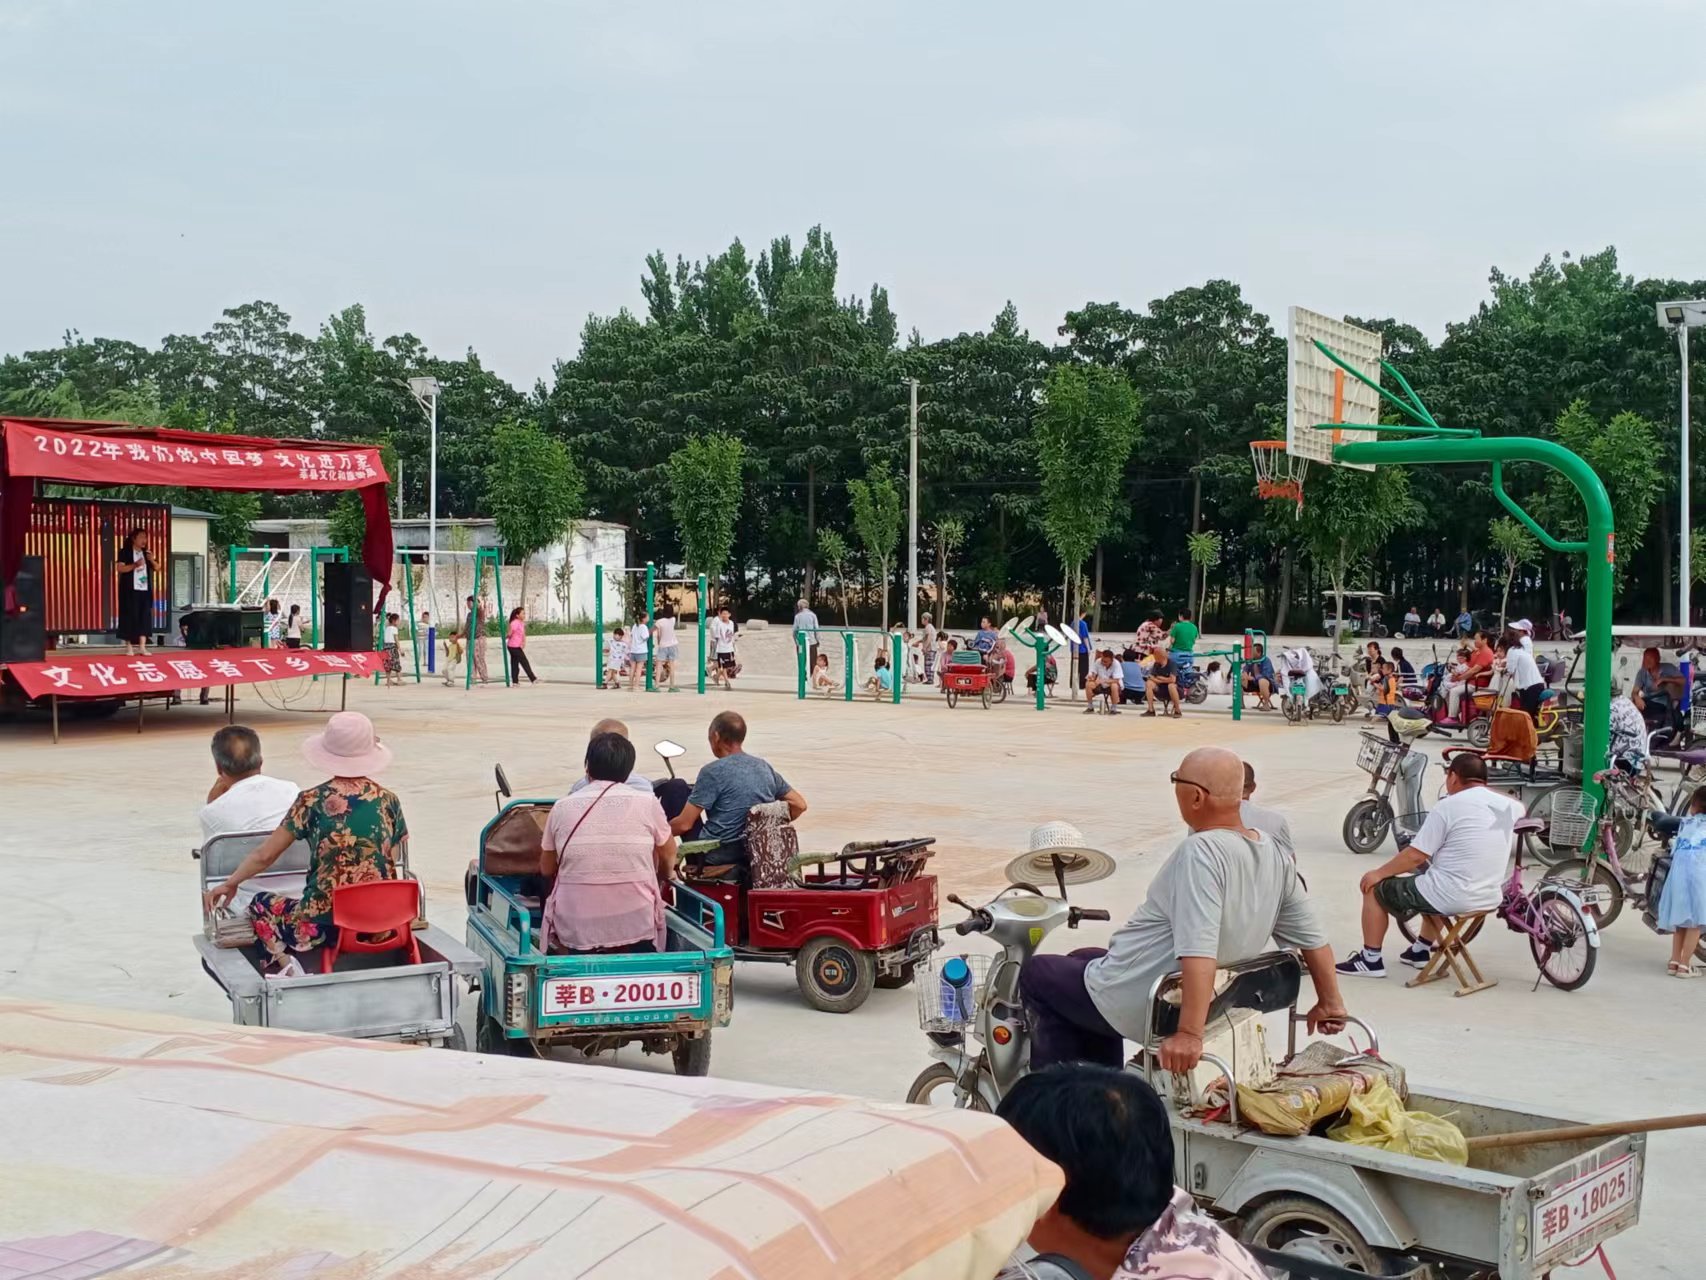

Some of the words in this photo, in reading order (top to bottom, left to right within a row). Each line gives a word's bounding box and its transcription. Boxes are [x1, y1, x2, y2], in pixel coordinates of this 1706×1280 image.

[34, 435, 263, 466] 2022年我们的中国梦
[274, 452, 370, 470] 文化进万家
